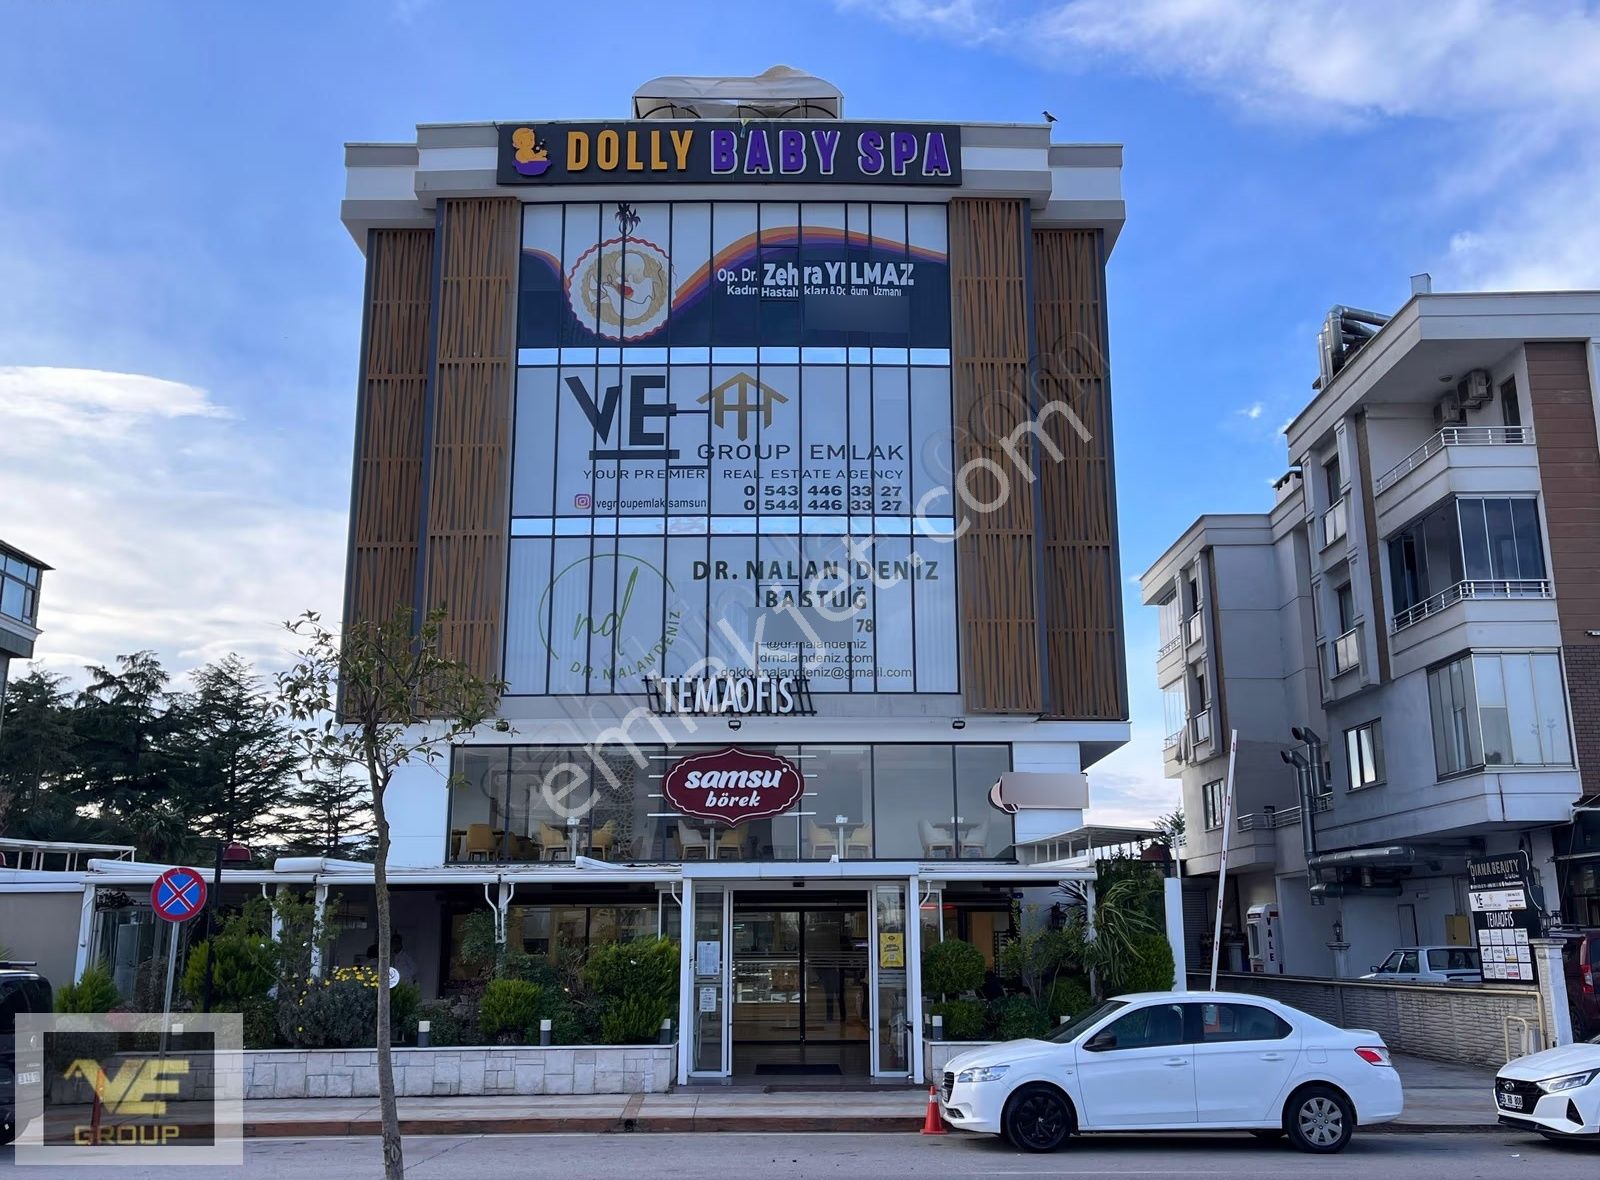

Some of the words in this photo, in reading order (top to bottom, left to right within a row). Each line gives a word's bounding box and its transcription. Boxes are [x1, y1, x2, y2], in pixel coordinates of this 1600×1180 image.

[566, 129, 694, 172] DOLLY
[710, 129, 841, 175] BABY
[857, 130, 951, 176] SPA
[717, 268, 738, 285] Op.
[741, 268, 758, 283] Dr.
[825, 261, 915, 286] YILMAZ
[697, 444, 790, 460] GROUP
[810, 445, 904, 460] EMLAK
[583, 470, 629, 480] YOUR
[634, 469, 706, 480] PREMIER
[723, 469, 764, 480] REAL
[771, 469, 833, 480] ESTATE
[836, 470, 904, 480] AGENCY
[744, 486, 756, 497] 0
[764, 485, 799, 496] 543
[807, 486, 843, 497] 446
[850, 486, 873, 497] 33
[880, 486, 903, 497] 27
[744, 500, 756, 511] 0
[764, 500, 799, 511] 544
[807, 500, 843, 511] 446
[850, 500, 873, 511] 33
[880, 500, 902, 511] 27
[693, 561, 738, 580] DR.
[746, 561, 839, 580] NALAN
[856, 618, 874, 633] 78
[684, 769, 782, 789] samsu
[705, 790, 761, 808] börek
[1491, 859, 1519, 875] BEAUTY
[1266, 917, 1275, 962] VALE
